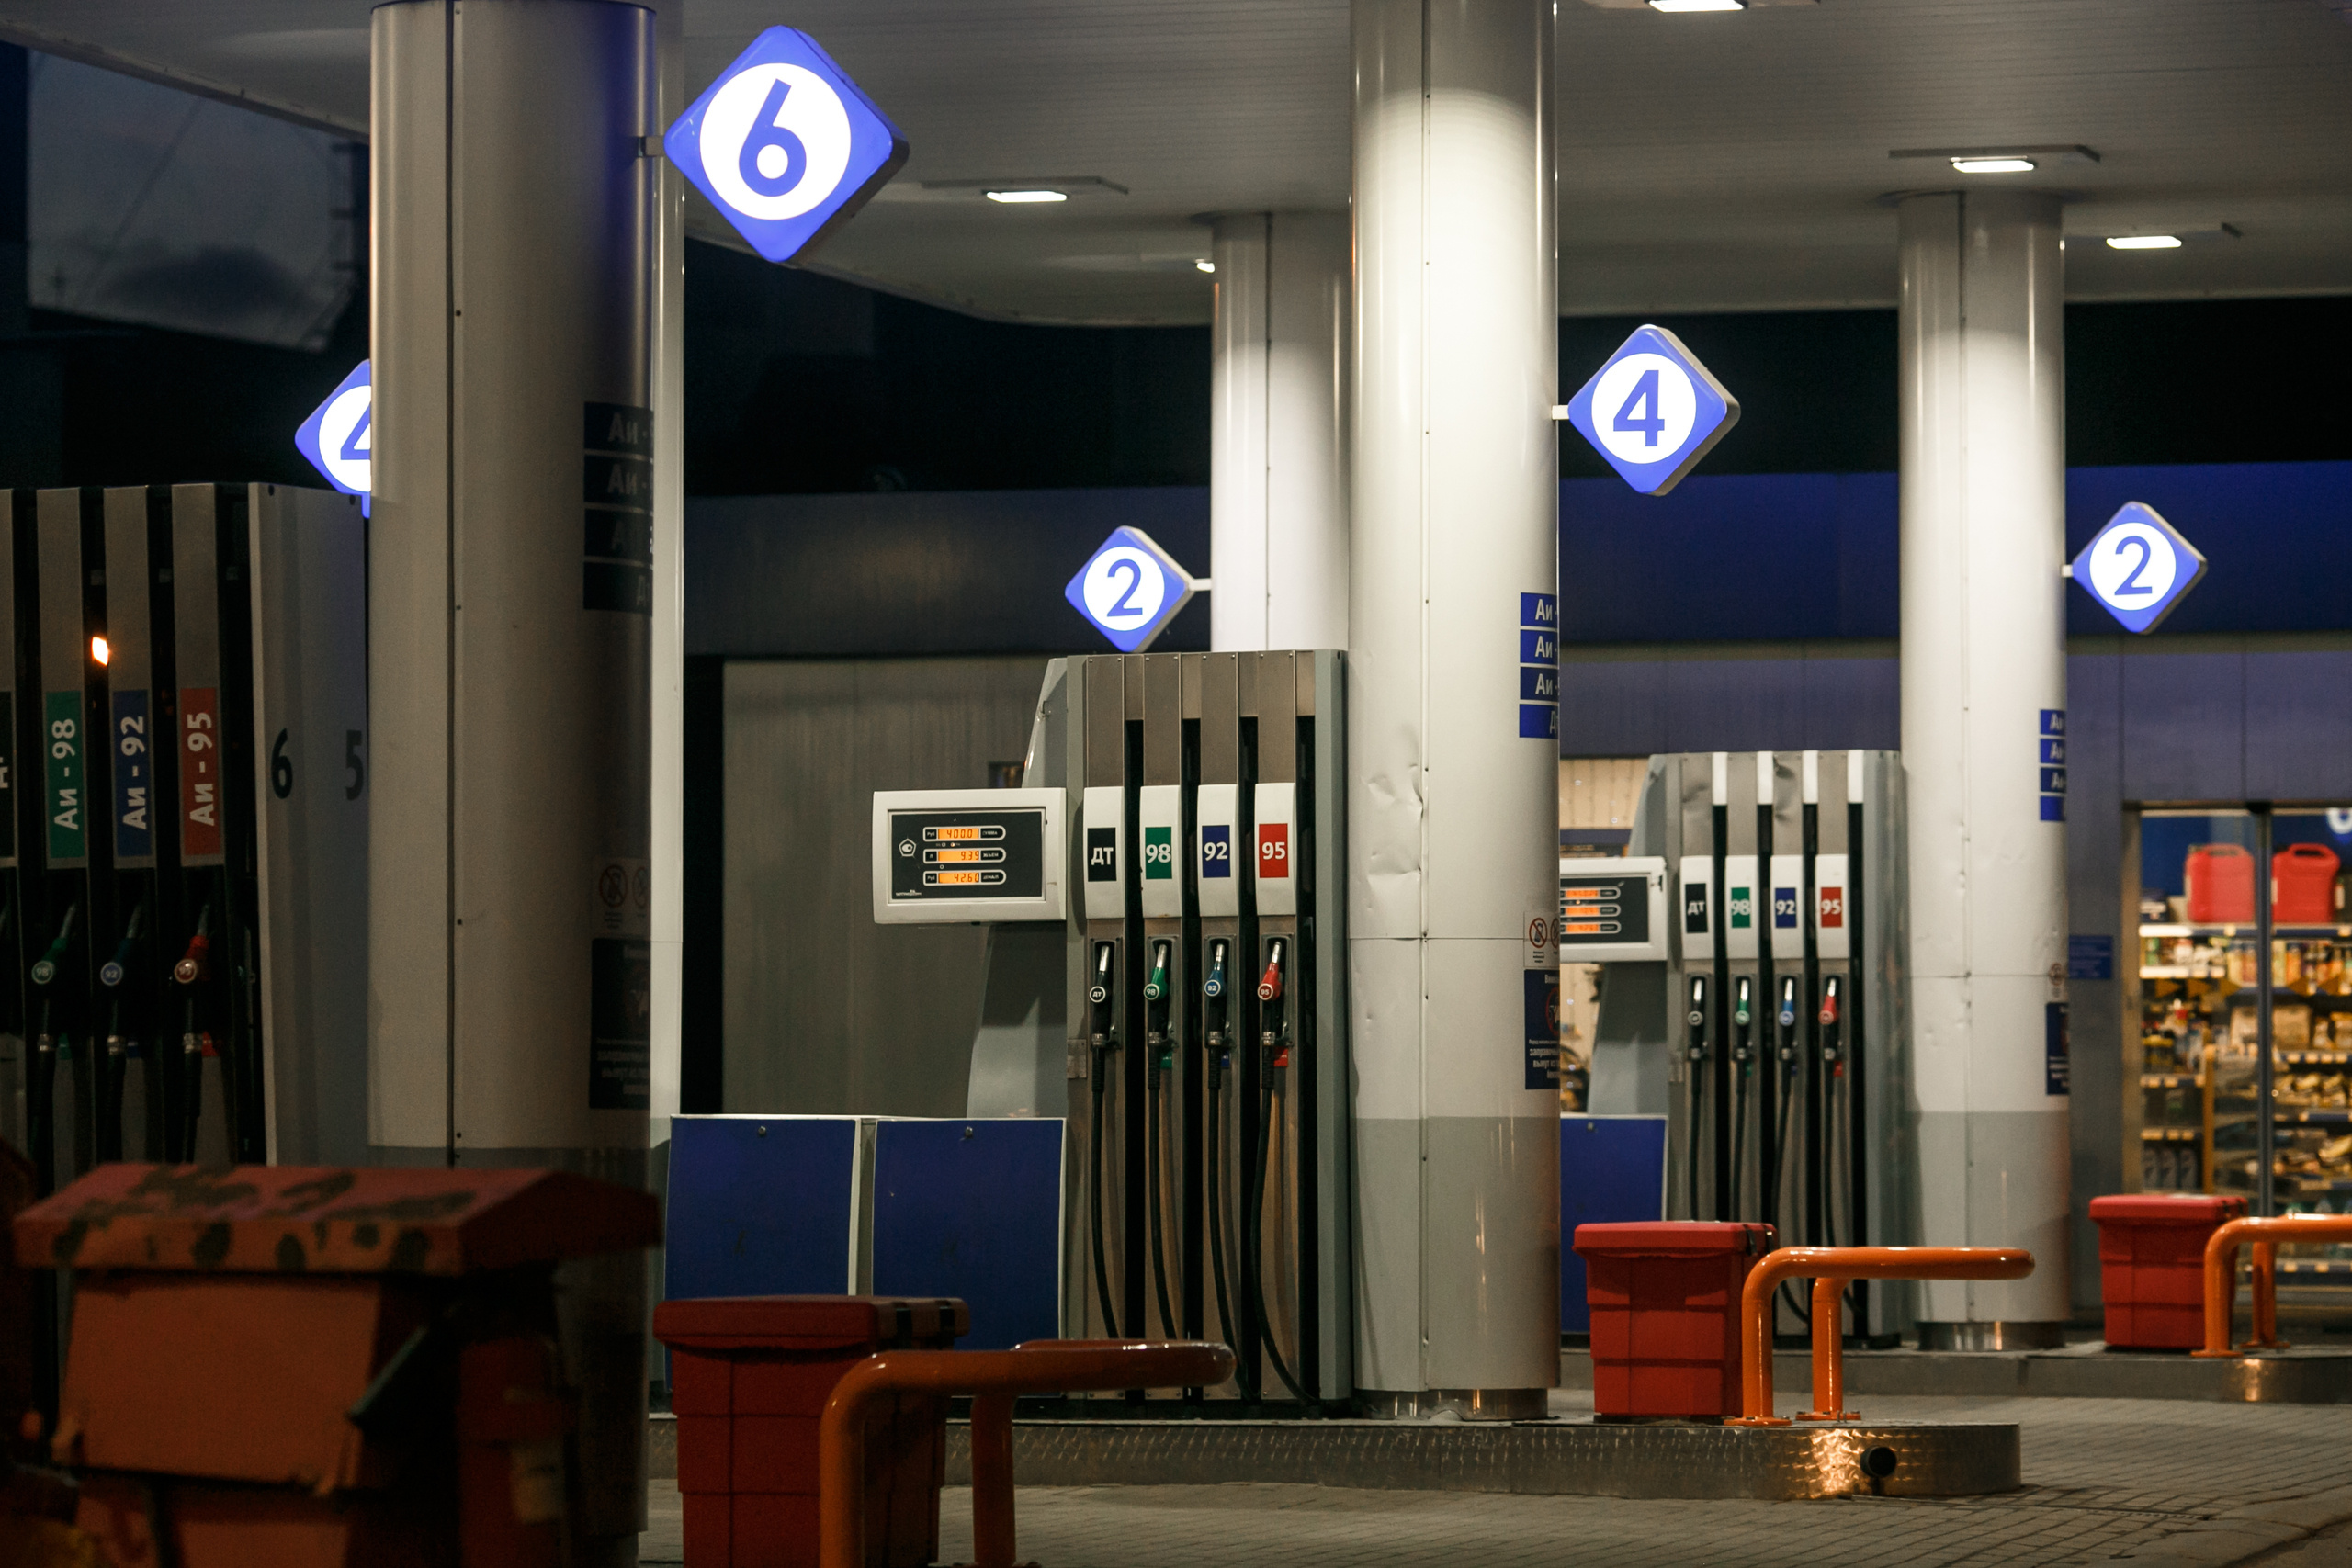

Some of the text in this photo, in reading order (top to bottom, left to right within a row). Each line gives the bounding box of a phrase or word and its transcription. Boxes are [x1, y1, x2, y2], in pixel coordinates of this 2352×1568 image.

[739, 78, 807, 197] 6
[1613, 369, 1665, 447] 4
[2114, 535, 2153, 596] 2
[1106, 558, 1143, 617] 2
[1534, 598, 1553, 621] Аи
[1534, 635, 1553, 659] Аи
[1534, 672, 1553, 695] Аи
[51, 717, 76, 760] 98
[120, 716, 145, 756] 92
[187, 712, 213, 752] 95
[271, 728, 293, 799] 6
[345, 729, 364, 801] 5
[960, 851, 979, 861] 9.39
[1091, 846, 1114, 866] ДТ
[1145, 843, 1172, 863] 98
[1204, 841, 1228, 862] 92
[1261, 841, 1286, 860] 95
[954, 873, 979, 883] 42.60
[1731, 898, 1751, 916] 98
[1775, 899, 1796, 916] 92
[1820, 898, 1842, 916] 95
[105, 970, 118, 978] 92
[1146, 987, 1156, 996] 98
[1207, 984, 1217, 992] 92
